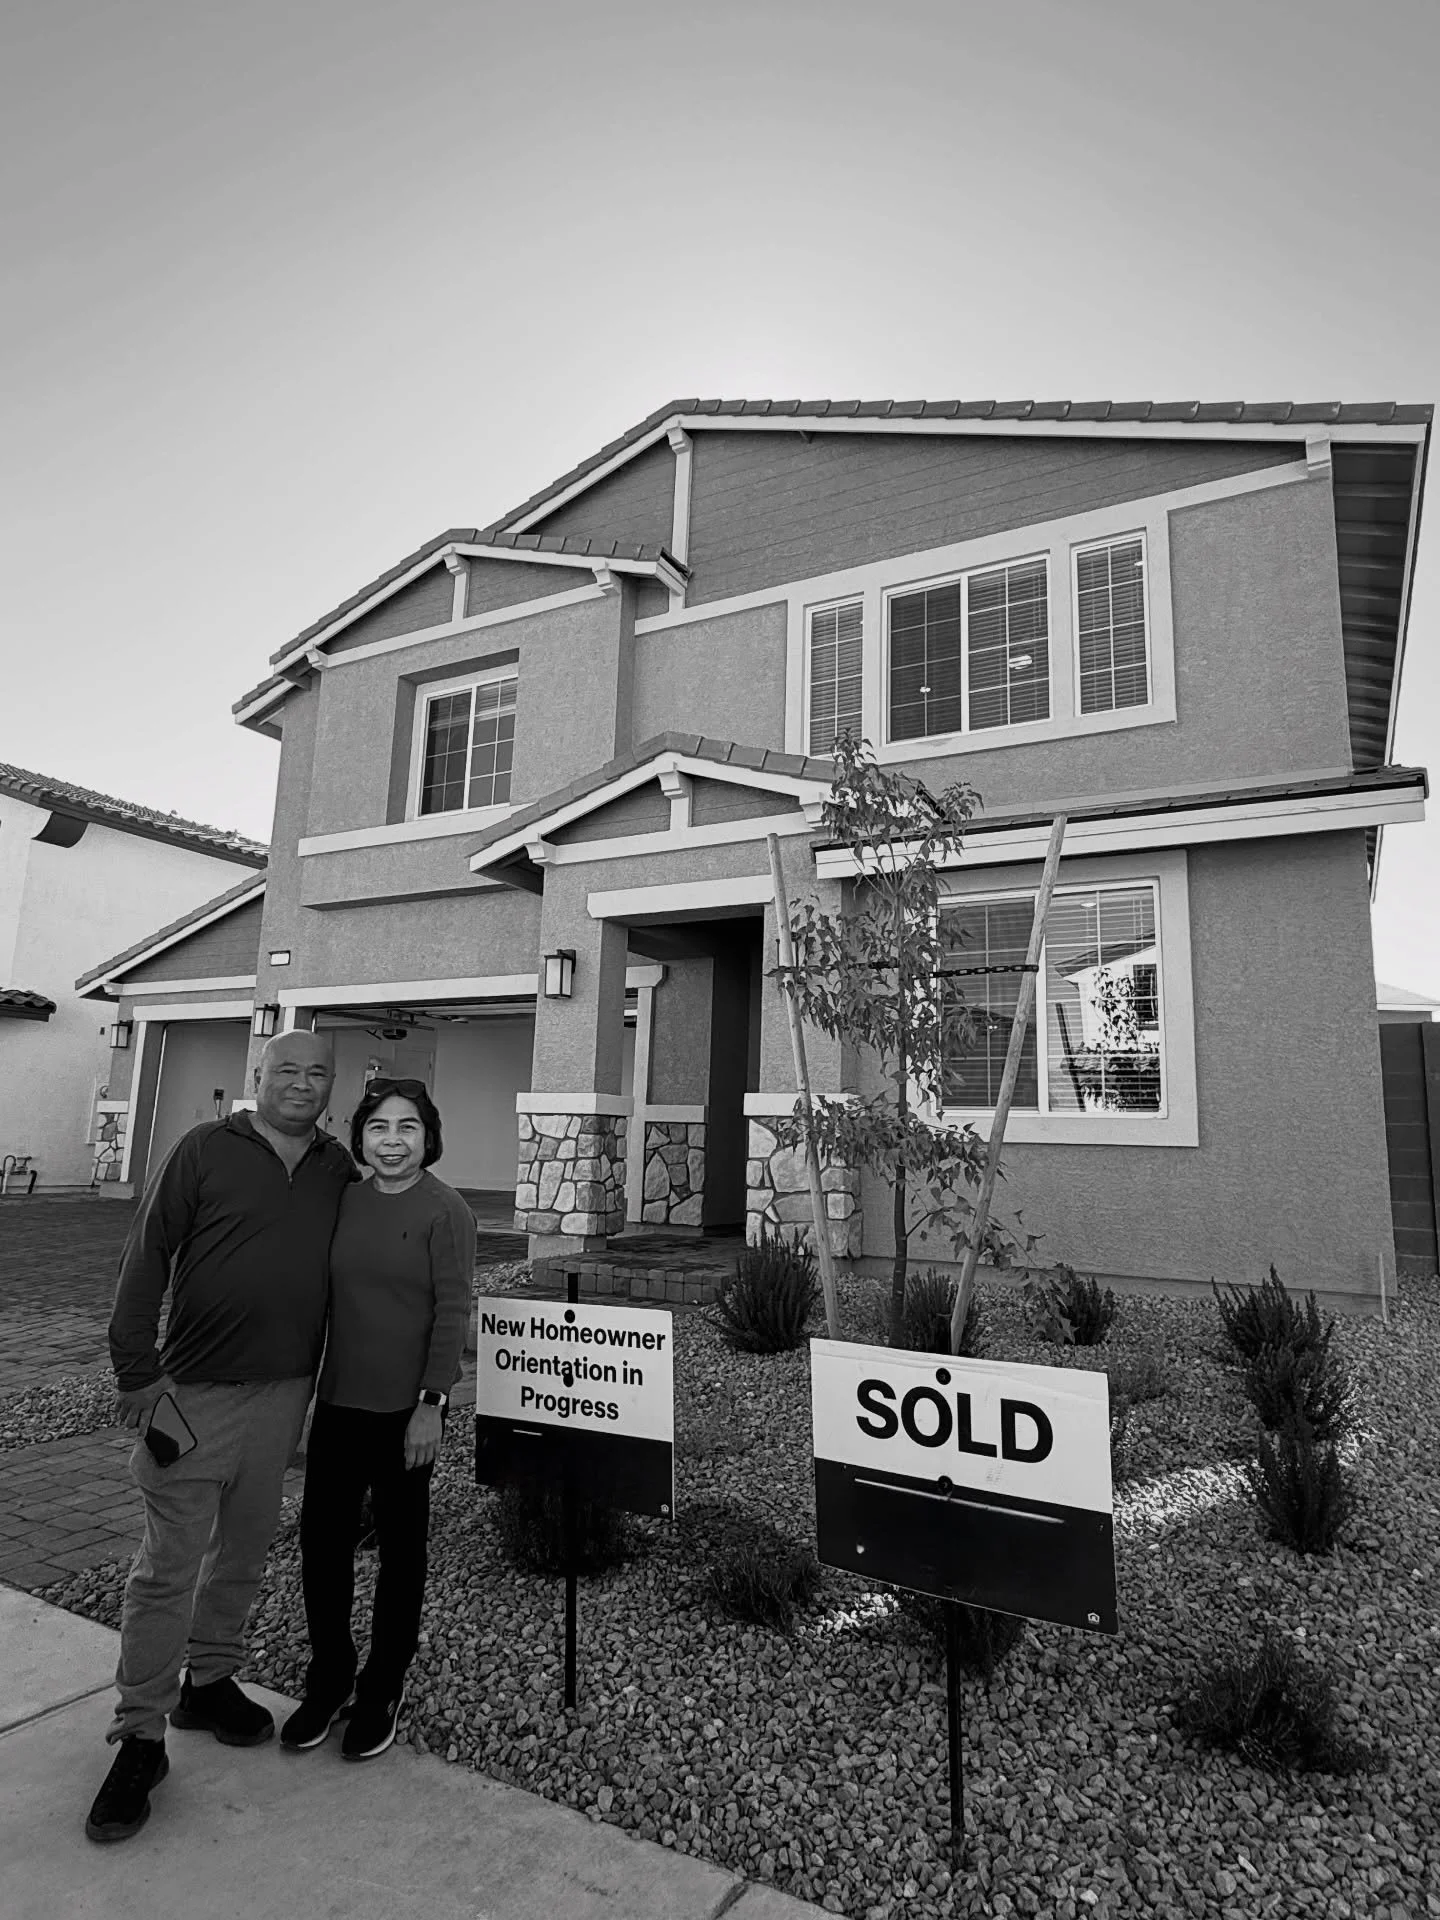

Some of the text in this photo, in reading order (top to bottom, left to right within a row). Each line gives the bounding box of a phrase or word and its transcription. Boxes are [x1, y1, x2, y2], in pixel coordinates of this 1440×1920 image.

[481, 1313, 666, 1351] New Homeowner
[495, 1348, 643, 1386] Orientation in
[520, 1385, 619, 1421] Progress
[855, 1378, 1054, 1464] SOLD
